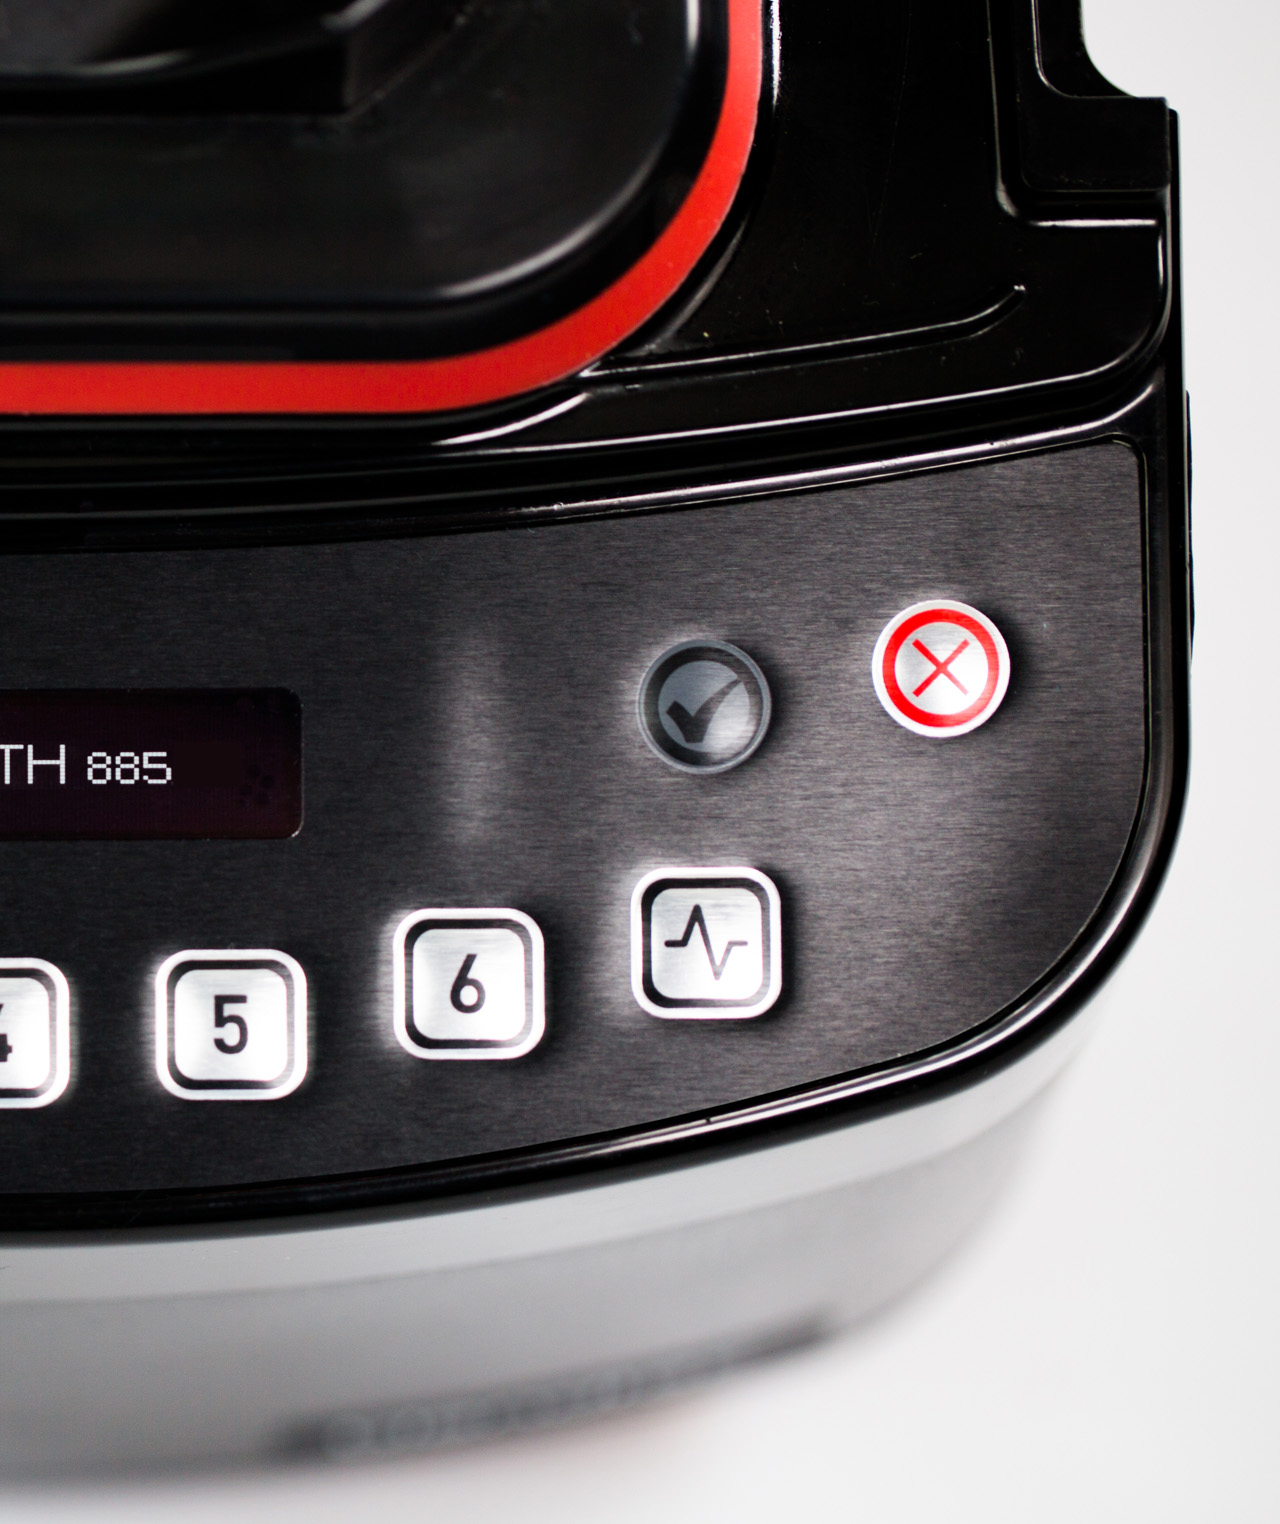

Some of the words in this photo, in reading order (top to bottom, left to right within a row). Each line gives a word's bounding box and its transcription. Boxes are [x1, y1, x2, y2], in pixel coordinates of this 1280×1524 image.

[87, 752, 173, 785] 885
[450, 953, 485, 1014] 6
[213, 994, 248, 1055] 5
